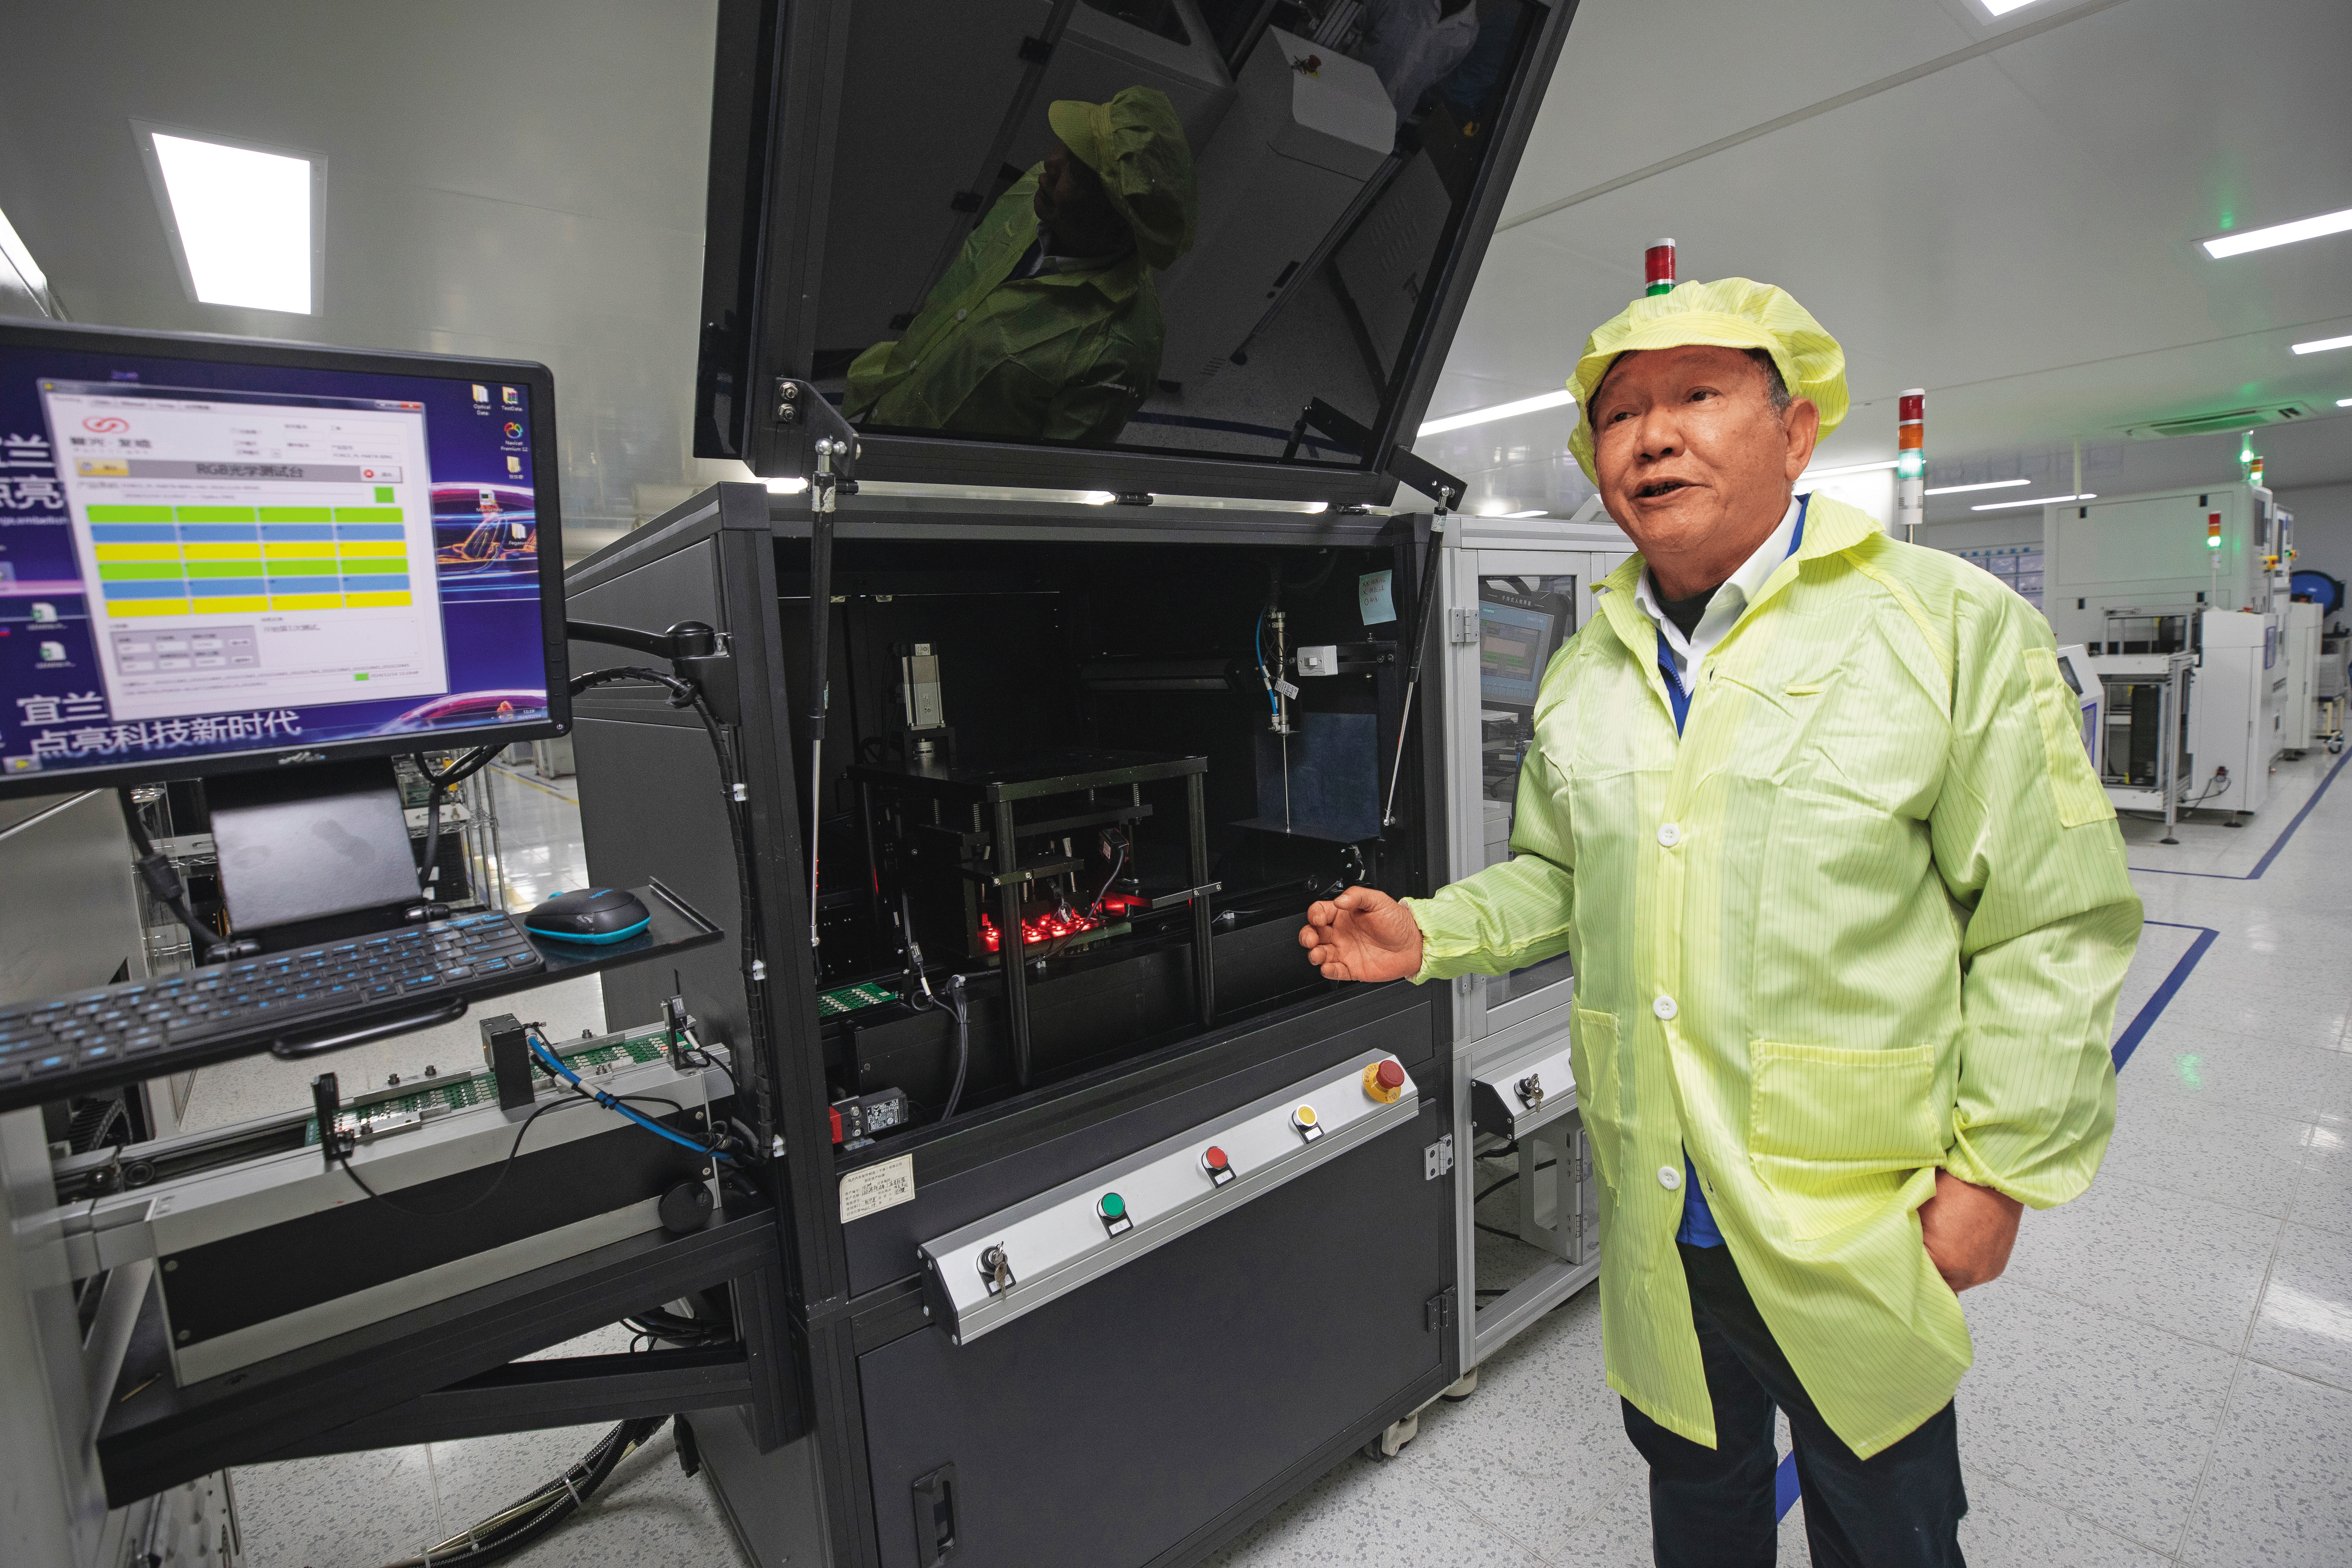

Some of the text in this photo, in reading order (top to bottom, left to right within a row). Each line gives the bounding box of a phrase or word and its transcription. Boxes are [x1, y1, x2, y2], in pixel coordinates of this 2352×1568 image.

[0, 433, 57, 468] 兰
[196, 463, 303, 478] RGB光学测试台
[1502, 595, 1532, 606] 手持式人机界面
[17, 691, 109, 727] 宜兰
[29, 710, 302, 755] 点亮科技新时代
[1385, 1092, 1398, 1102] STOP
